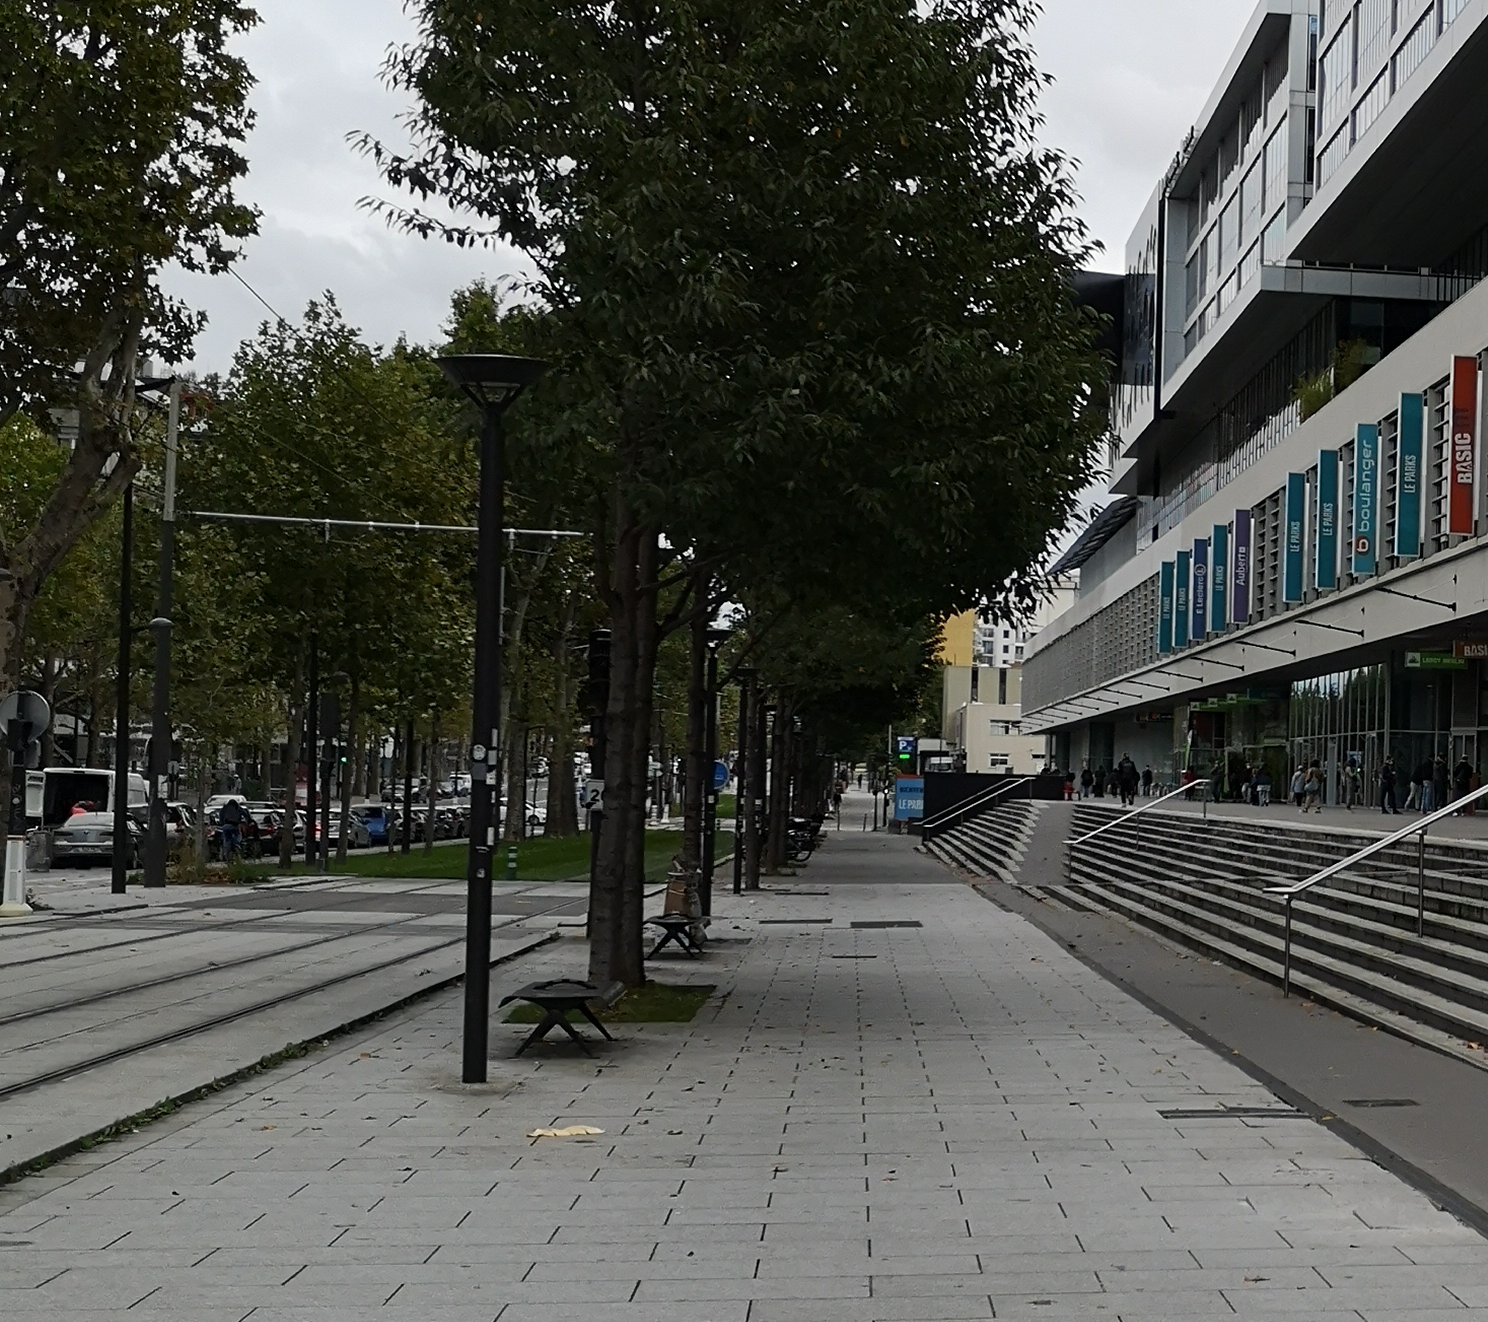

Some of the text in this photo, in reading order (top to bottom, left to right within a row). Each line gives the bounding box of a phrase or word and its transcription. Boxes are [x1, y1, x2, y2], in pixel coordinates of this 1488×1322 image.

[1403, 454, 1417, 493] LE PARKS
[1454, 433, 1473, 484] BASIC
[1359, 439, 1375, 532] boulanger
[1290, 521, 1301, 552] LE PARKS
[1322, 502, 1334, 536] LE PARKS
[1235, 552, 1247, 586] Aubert
